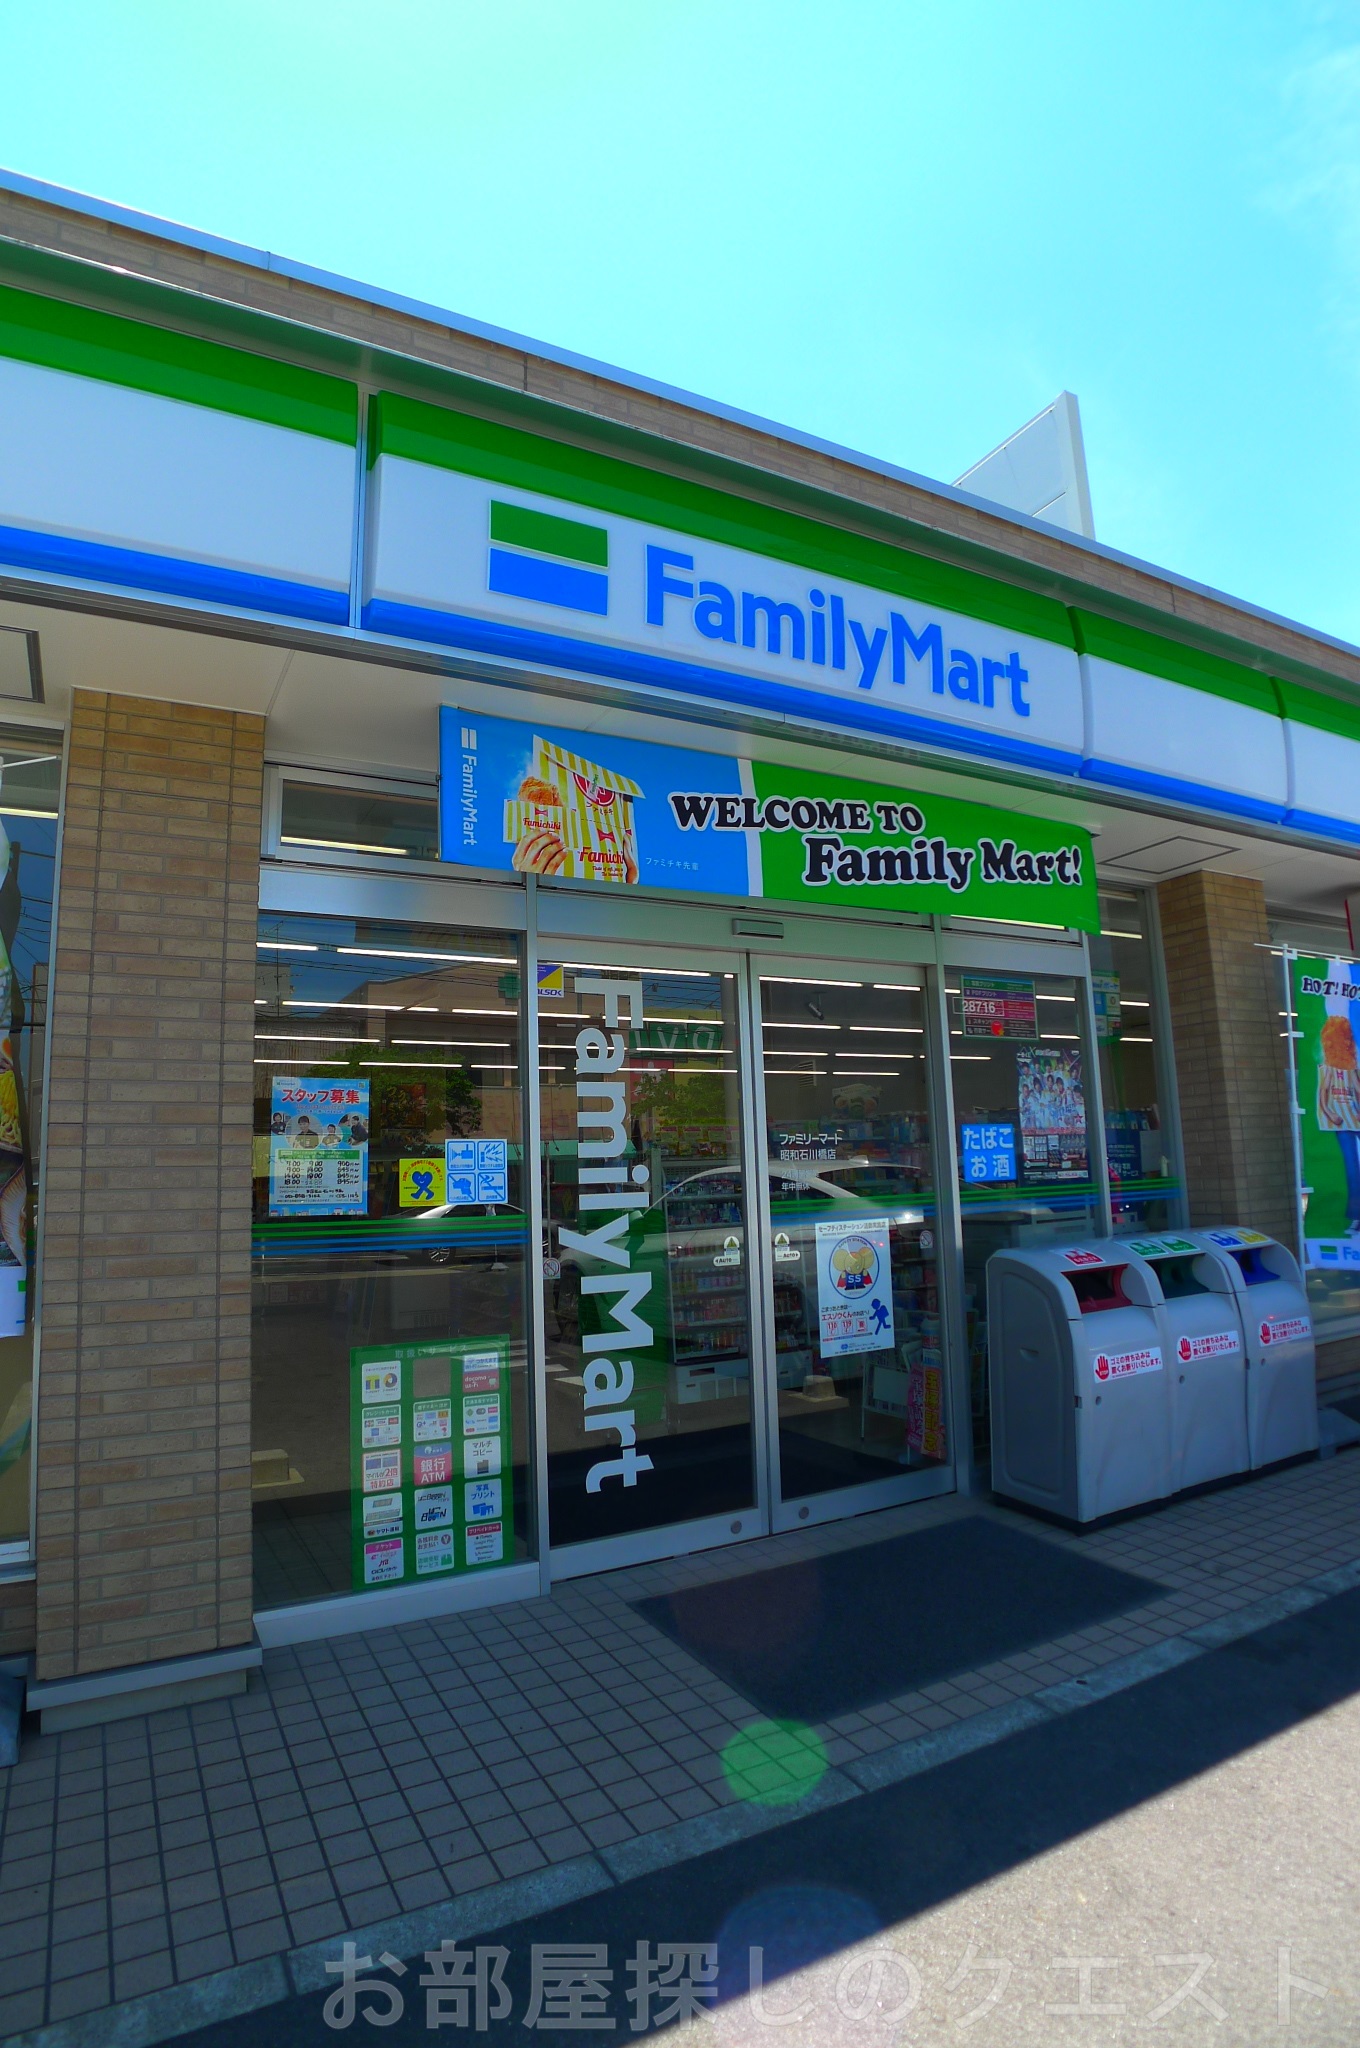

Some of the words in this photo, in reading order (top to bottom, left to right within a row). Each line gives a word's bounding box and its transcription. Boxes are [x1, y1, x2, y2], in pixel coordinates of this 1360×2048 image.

[645, 543, 1030, 716] FamilyMart
[462, 754, 478, 845] FamilyMart
[670, 794, 870, 832] WELCOME
[875, 803, 924, 835] TO
[523, 818, 561, 830] Famichiki
[578, 846, 625, 865] Famichi
[802, 836, 974, 892] Family
[978, 838, 1083, 885] Mart!
[1302, 977, 1339, 995] HOT!
[1341, 983, 1360, 999] HO
[962, 1000, 996, 1013] 28716
[282, 1088, 360, 1104] スタッフ募集
[779, 1133, 842, 1145] ファミリーマート
[963, 1127, 1014, 1150] たばこ
[780, 1149, 836, 1161] 昭和石川橋店
[970, 1154, 1010, 1178] お酒
[558, 977, 655, 1494] FamilyMart
[848, 1274, 861, 1283] SS
[395, 1345, 467, 1358] 取扱いサビス
[472, 1440, 493, 1448] マルチ
[473, 1449, 493, 1457] コピー
[420, 1458, 446, 1473] 銀行
[420, 1472, 446, 1484] ATM
[470, 1490, 496, 1499] プリント
[468, 1524, 500, 1534] プリペイドカード
[418, 1561, 439, 1570] サービス
